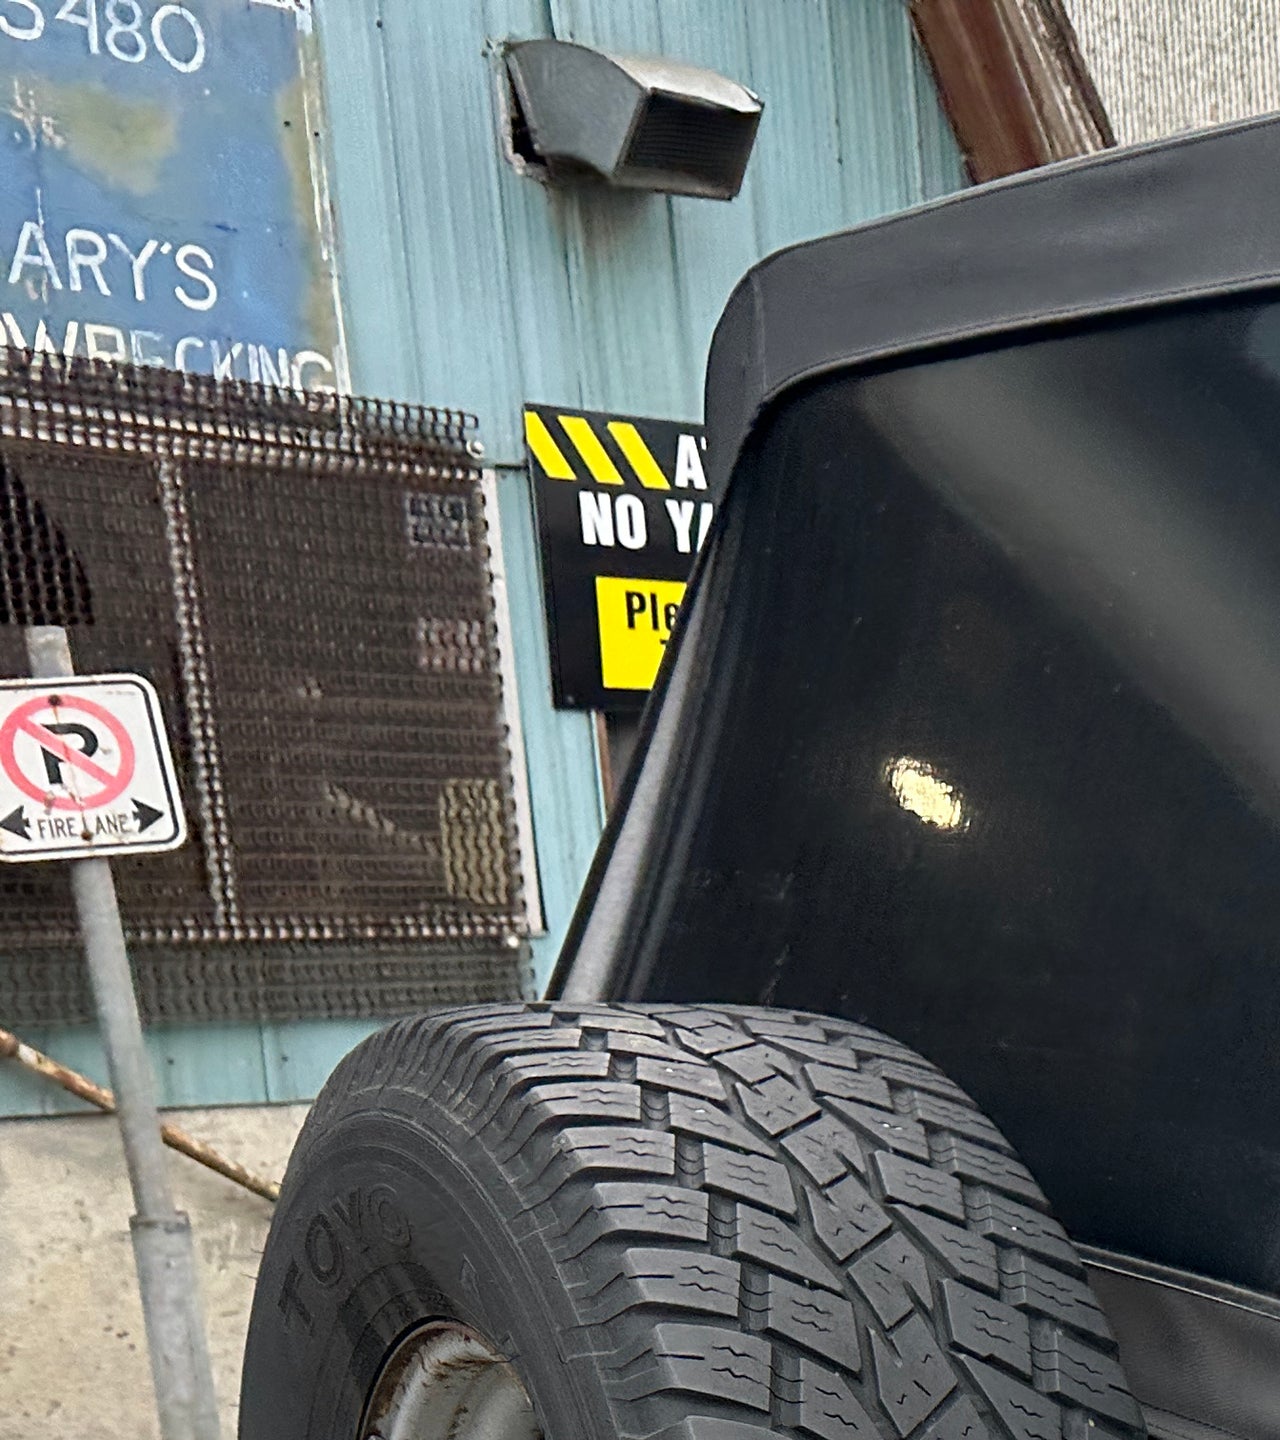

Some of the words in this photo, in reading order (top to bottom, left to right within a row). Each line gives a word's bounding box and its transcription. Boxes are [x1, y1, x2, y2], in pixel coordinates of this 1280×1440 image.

[8, 221, 218, 311] ARY'S
[675, 434, 707, 490] A
[579, 491, 647, 549] NO
[37, 816, 78, 839] FIRE
